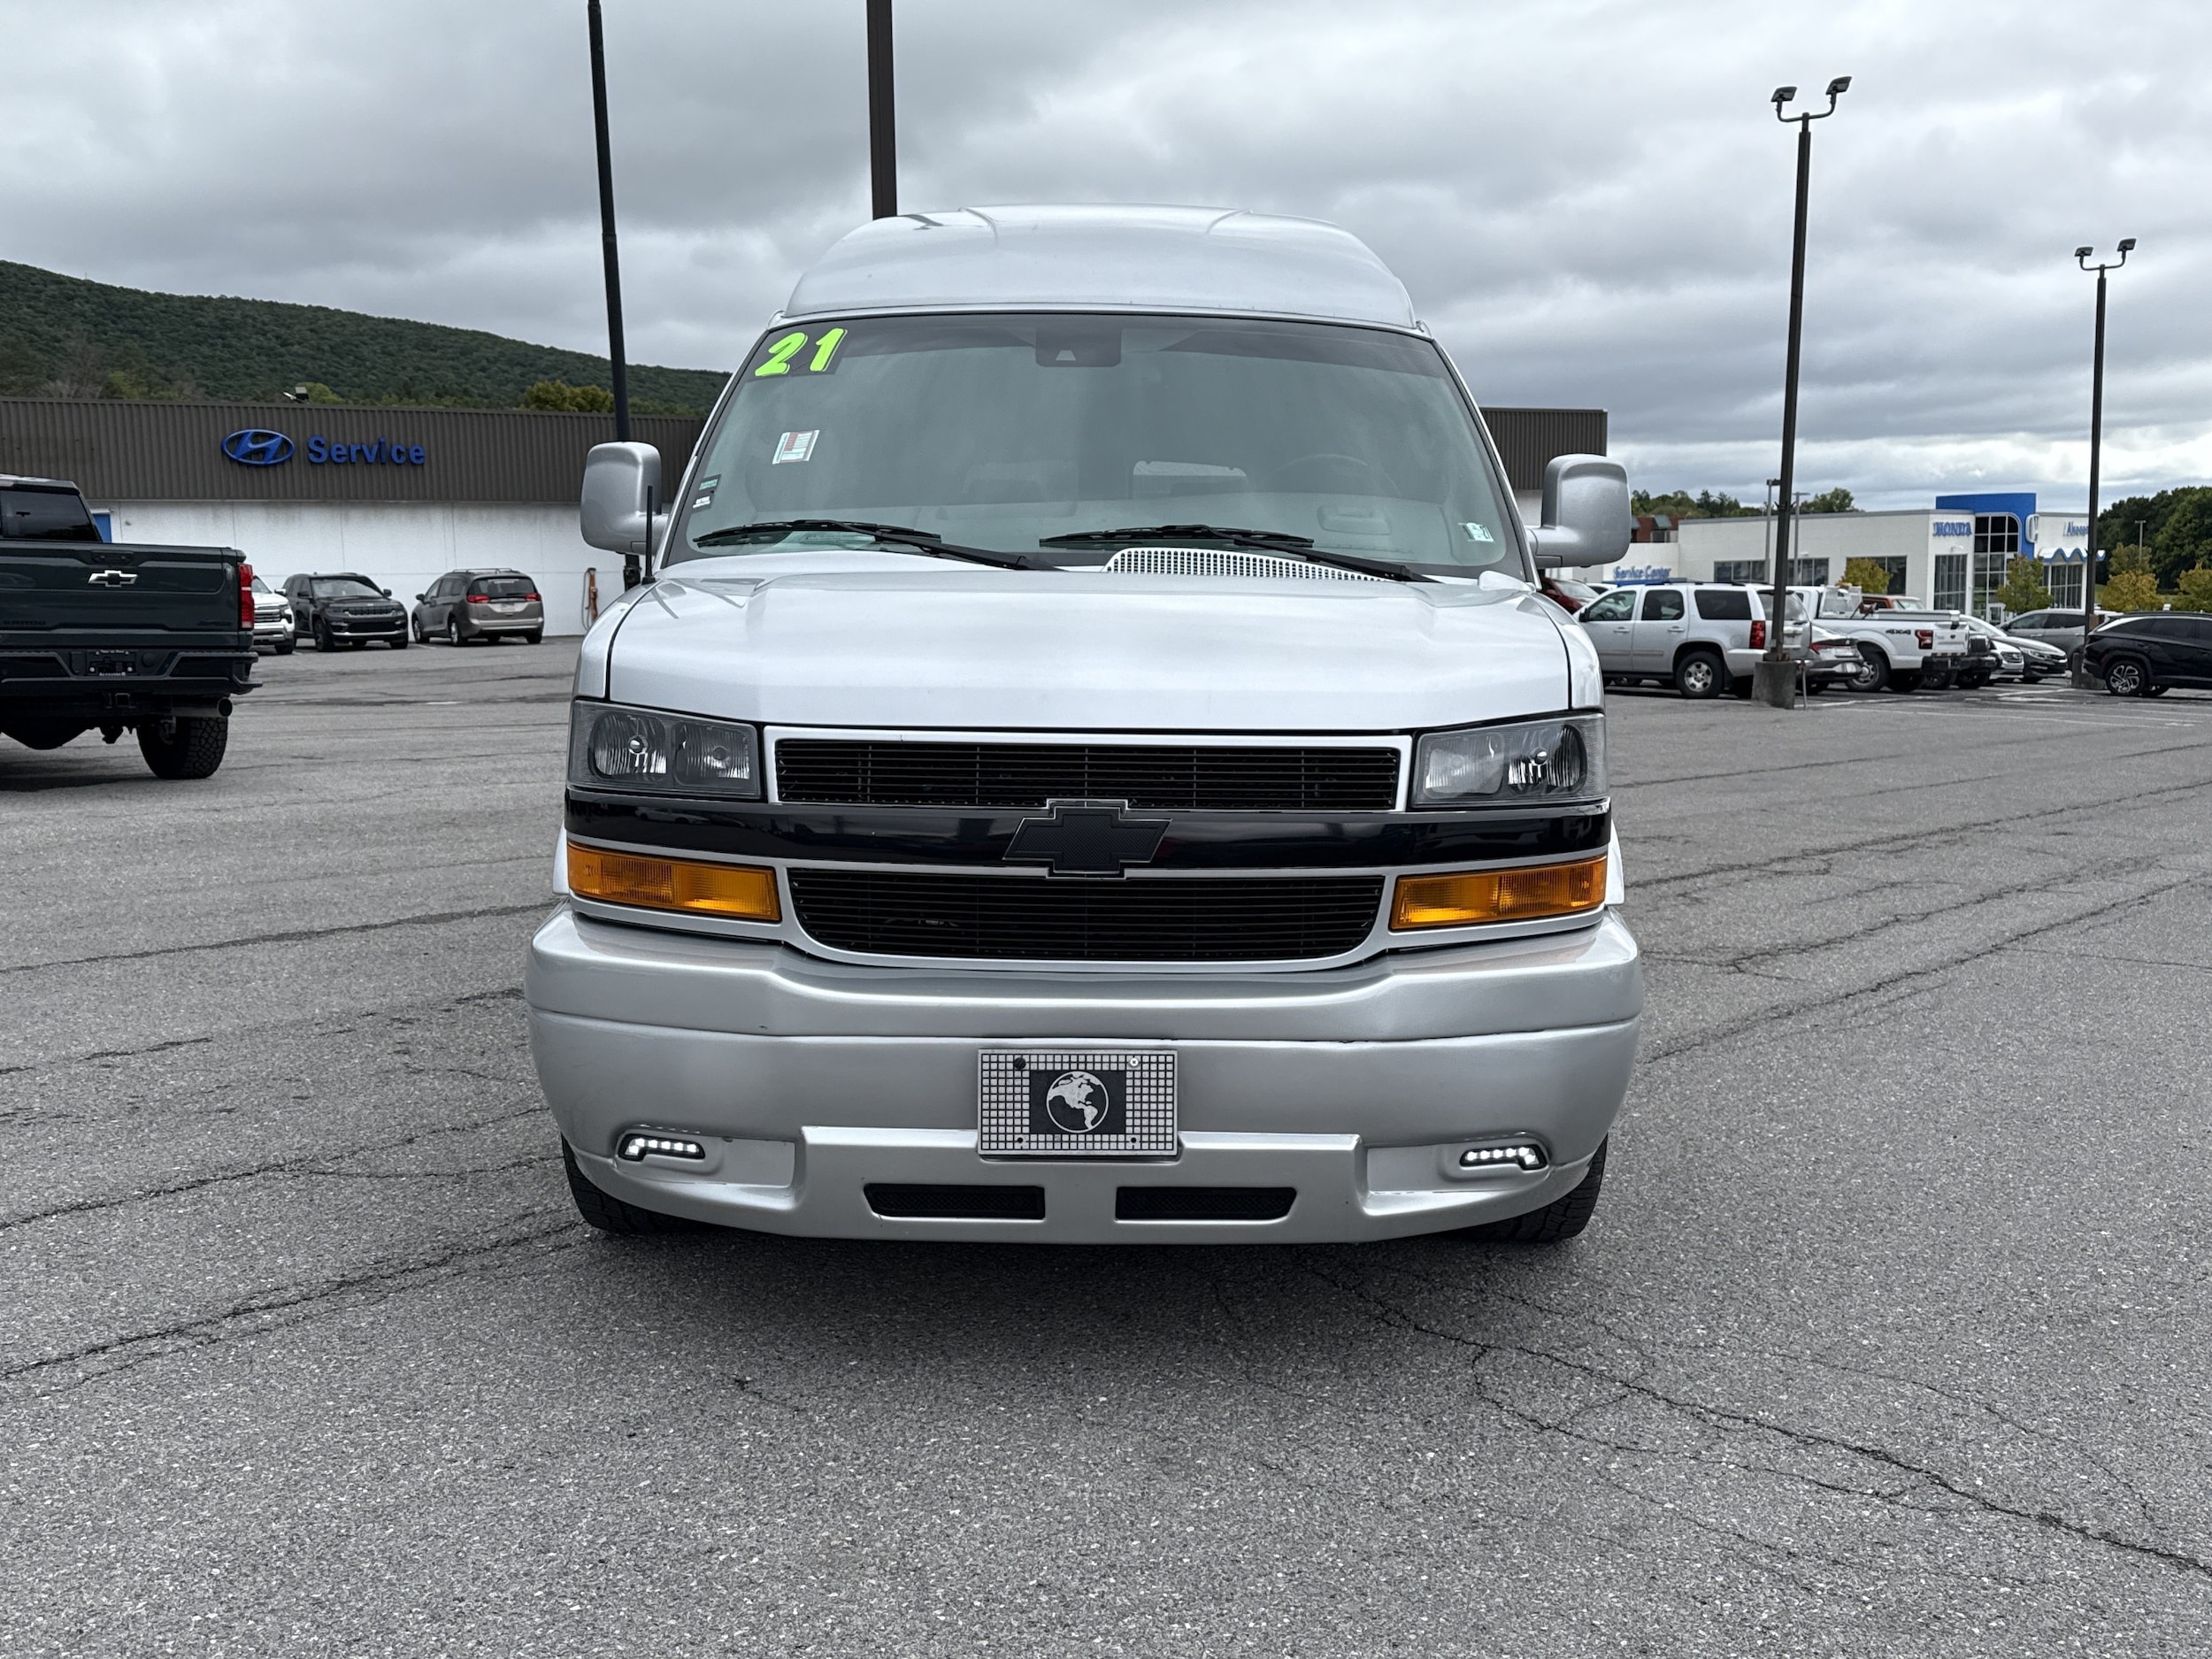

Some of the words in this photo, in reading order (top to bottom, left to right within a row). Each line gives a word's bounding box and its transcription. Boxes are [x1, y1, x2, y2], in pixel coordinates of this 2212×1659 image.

[755, 327, 848, 377] 21
[308, 435, 426, 465] Service
[1932, 522, 1973, 537] HONDA
[1614, 565, 1644, 580] Service
[1646, 565, 1671, 579] Center
